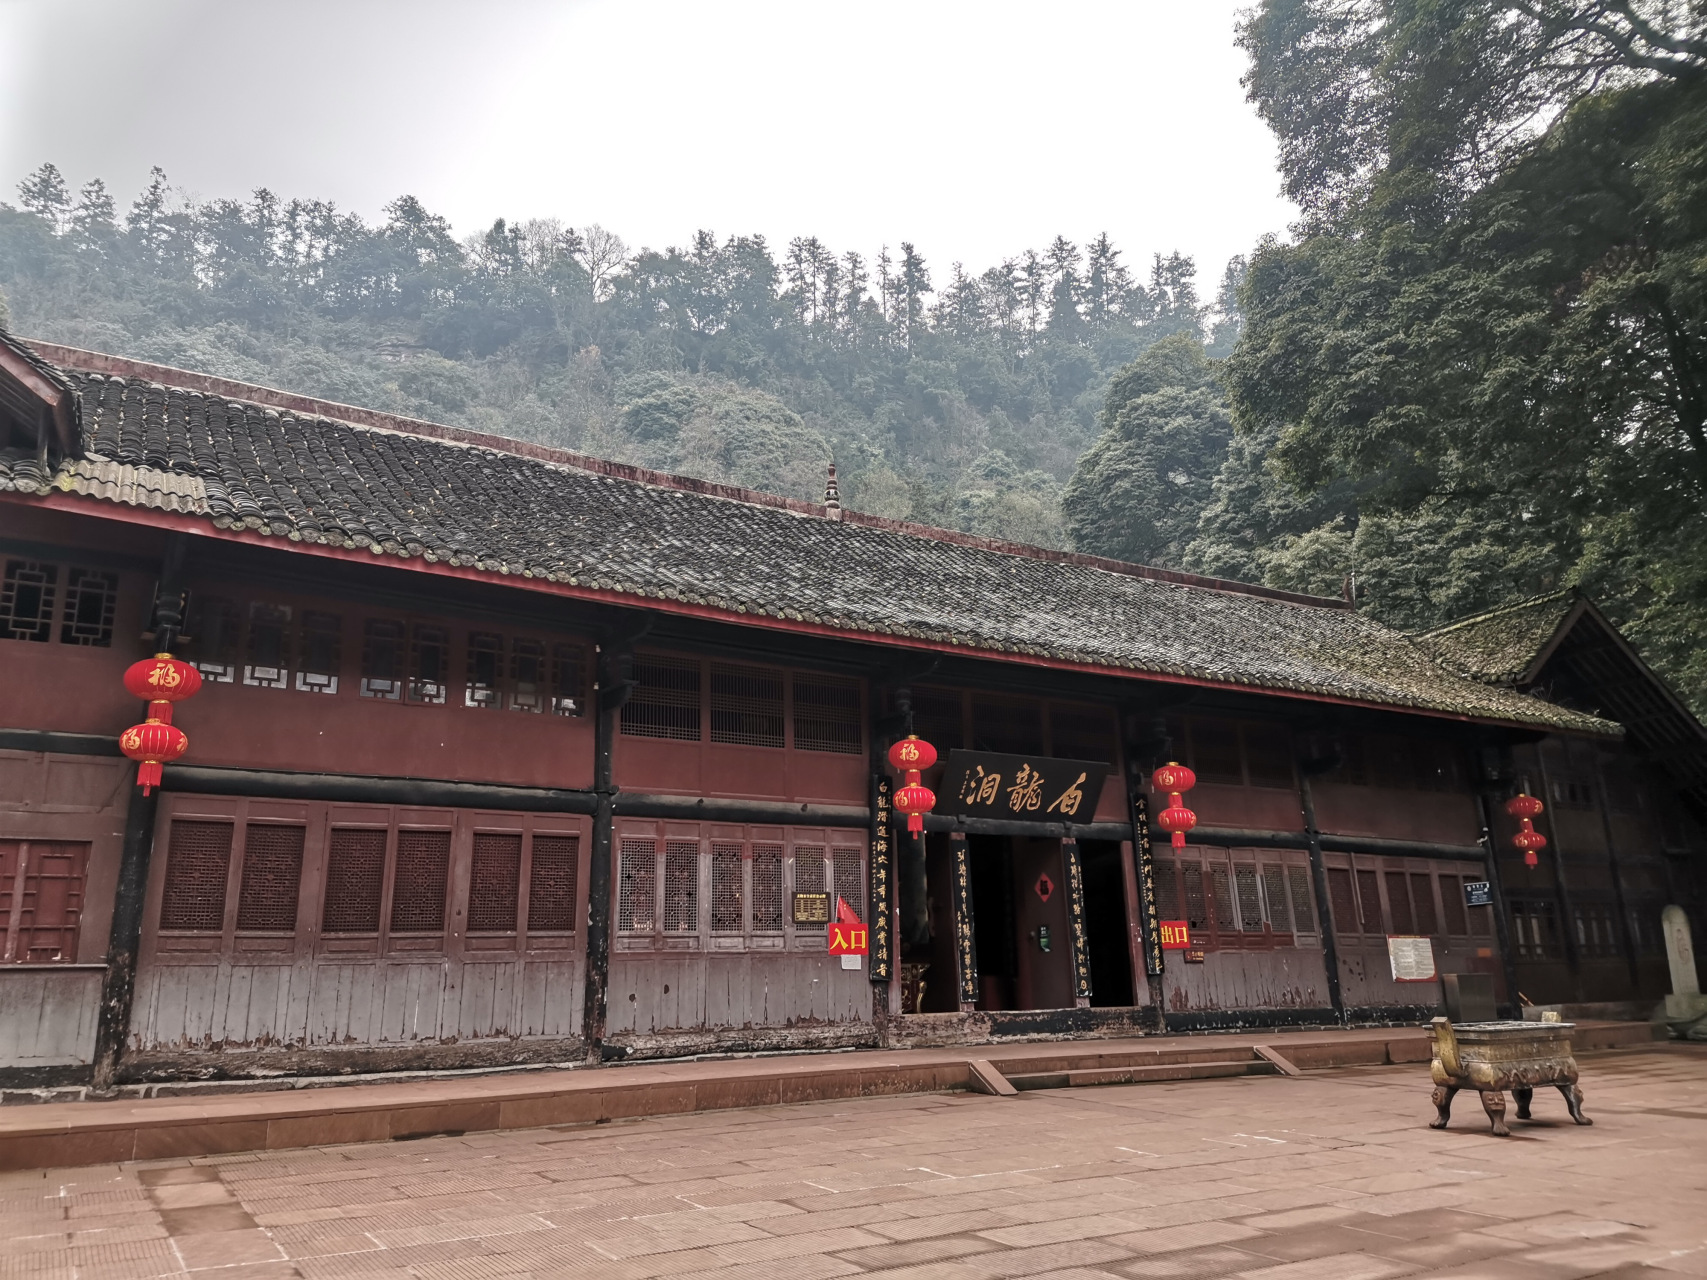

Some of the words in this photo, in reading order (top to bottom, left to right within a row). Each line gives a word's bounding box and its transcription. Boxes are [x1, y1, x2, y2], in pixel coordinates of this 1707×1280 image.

[147, 662, 180, 688] 福
[121, 728, 141, 750] 福
[899, 743, 920, 761] 福
[894, 791, 908, 807] 福
[966, 762, 1087, 816] 白龍洞
[830, 927, 866, 950] 入口
[1161, 925, 1188, 944] 出口
